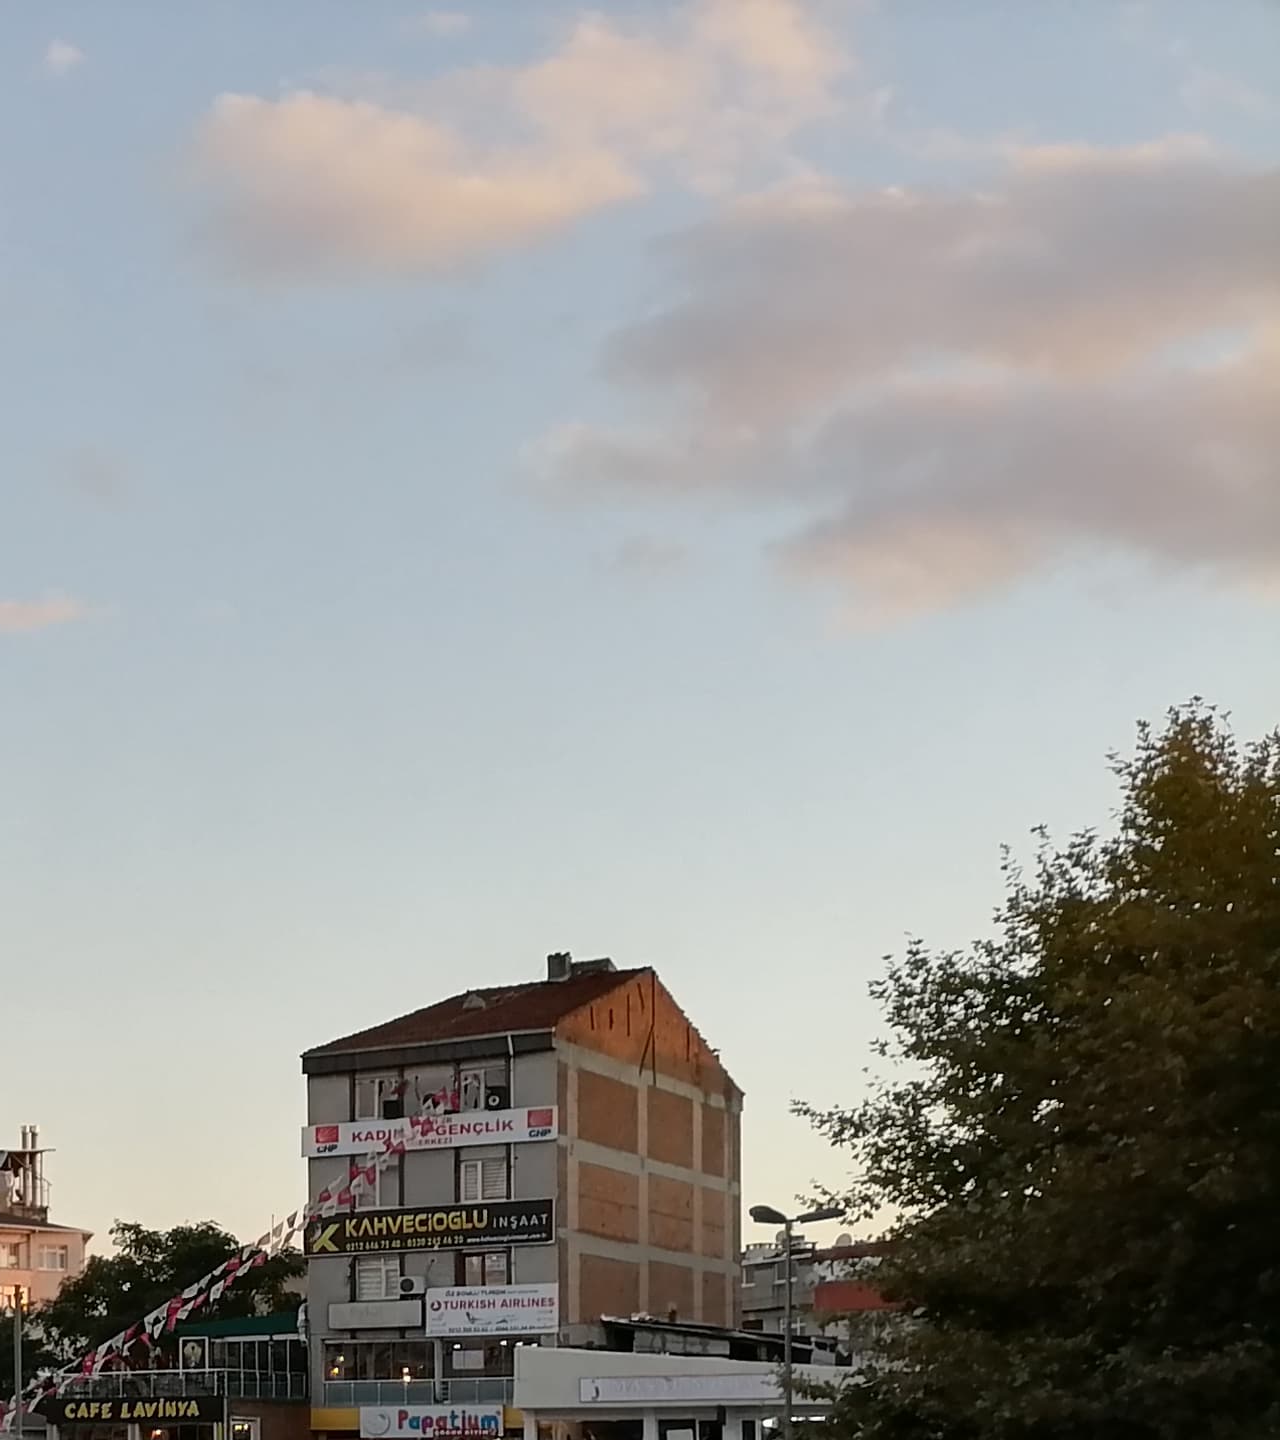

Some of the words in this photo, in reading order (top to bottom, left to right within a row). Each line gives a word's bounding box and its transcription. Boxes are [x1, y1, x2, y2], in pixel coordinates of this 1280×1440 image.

[435, 1118, 515, 1138] GENÇLİK
[443, 1299, 496, 1311] TURKISH
[500, 1297, 555, 1308] AIRLINES
[64, 1401, 112, 1419] CAFE
[120, 1398, 200, 1419] LAVİNYA
[397, 1409, 500, 1435] Papatium
